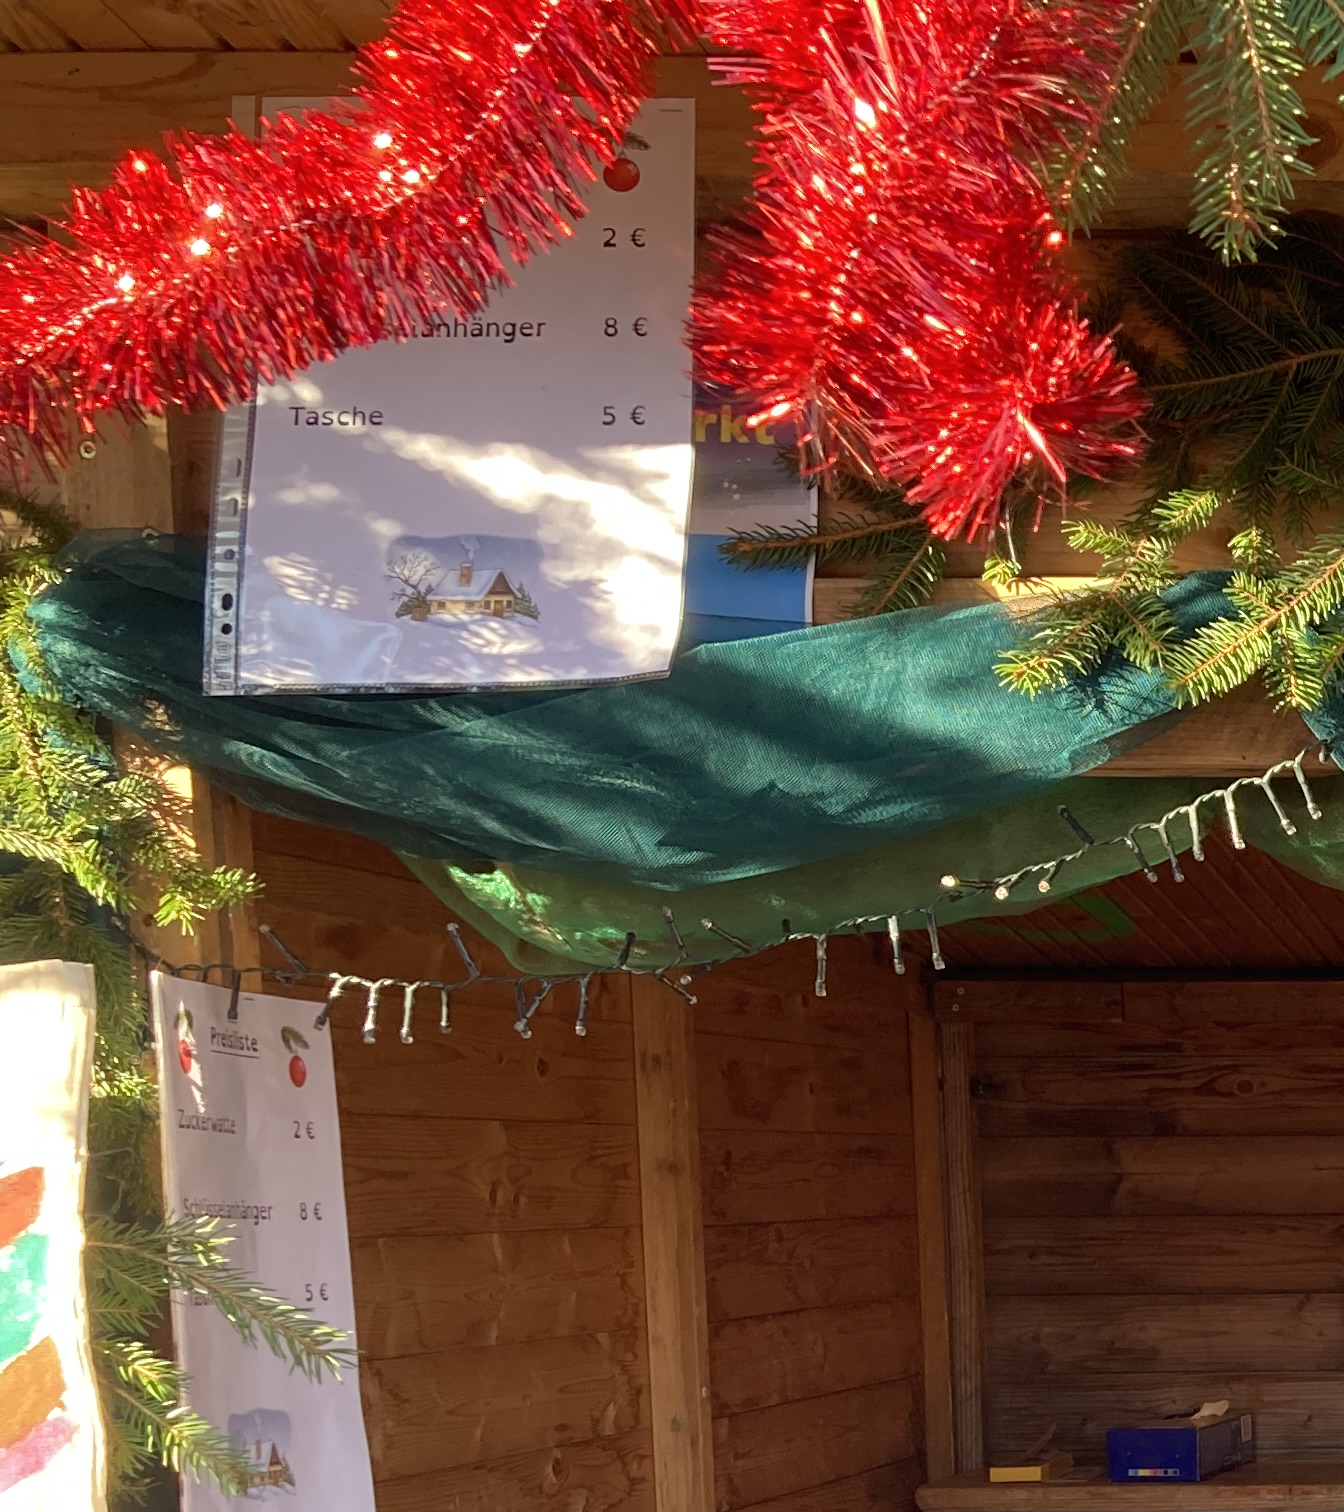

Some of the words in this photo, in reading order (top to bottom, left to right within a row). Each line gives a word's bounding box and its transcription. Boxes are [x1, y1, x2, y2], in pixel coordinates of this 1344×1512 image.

[602, 228, 617, 248] 2
[630, 228, 646, 248] €
[603, 318, 618, 338] 8
[632, 318, 648, 338] €
[289, 406, 384, 427] Tasche
[602, 406, 616, 426] 5
[630, 406, 646, 426] €
[210, 1026, 258, 1053] Preisliste
[177, 1109, 236, 1134] Zuckerwatte
[293, 1121, 301, 1139] 2
[306, 1121, 315, 1140] €
[299, 1202, 308, 1220] 8
[313, 1202, 322, 1221] €
[305, 1283, 313, 1302] 5
[319, 1283, 329, 1301] €
